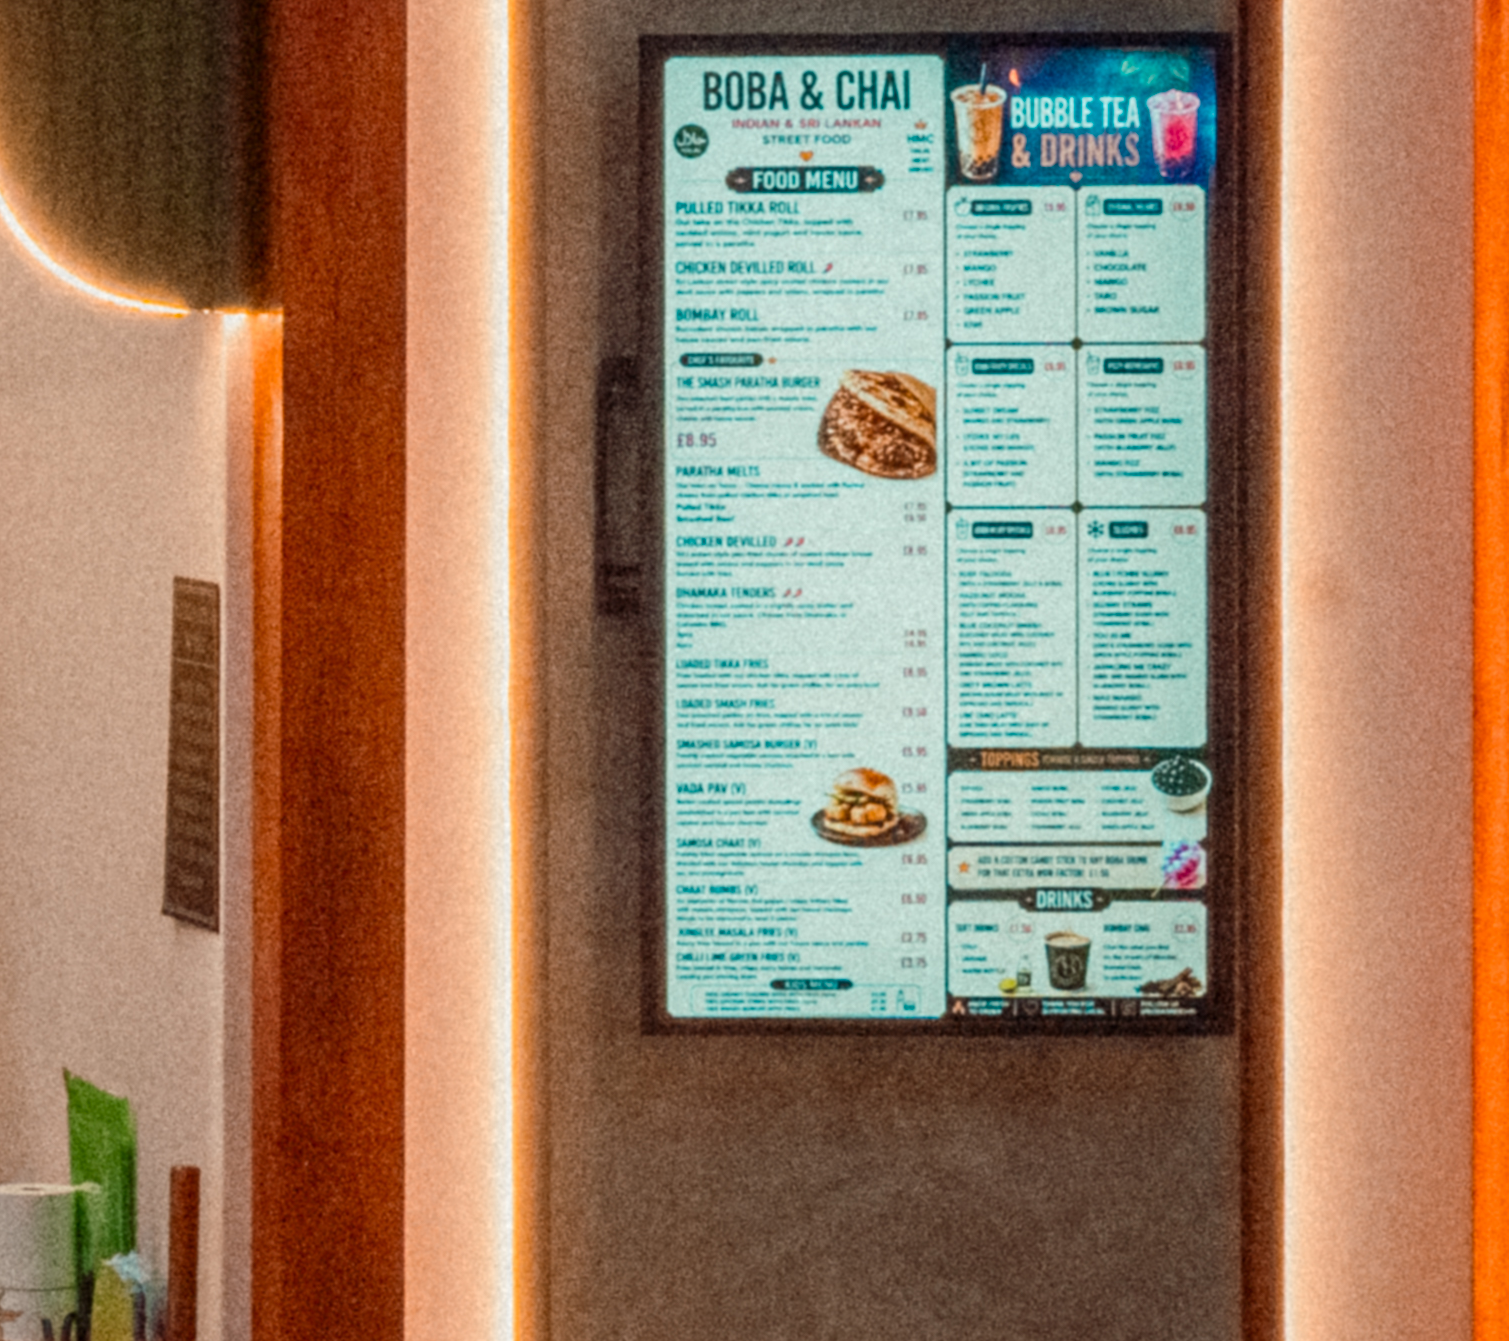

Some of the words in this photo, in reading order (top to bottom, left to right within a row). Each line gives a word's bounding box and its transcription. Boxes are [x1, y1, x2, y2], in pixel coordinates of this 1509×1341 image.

[703, 70, 789, 111] BOBA
[800, 70, 823, 111] &
[836, 70, 910, 111] CHAI
[1011, 97, 1094, 128] BUBBLE
[1099, 97, 1140, 128] TEA
[732, 119, 779, 128] INDIAN
[785, 119, 793, 128] &
[800, 119, 820, 128] SRI
[825, 119, 882, 128] LANKAN
[762, 135, 810, 145] STREET
[815, 135, 851, 145] FOOD
[1011, 133, 1031, 168] &
[1040, 133, 1140, 168] DRINKS
[752, 171, 800, 189] FOOD
[805, 171, 859, 189] MENU
[675, 201, 723, 214] PULLED
[728, 201, 765, 214] TIKKA
[769, 201, 800, 214] ROLL
[675, 260, 727, 274] CHICKEN
[730, 260, 784, 274] DEVILLED
[788, 260, 815, 274] ROLL
[675, 308, 726, 321] BOMBAY
[730, 308, 759, 321] ROLL
[677, 377, 693, 388] THE
[698, 377, 731, 388] SMASH
[735, 377, 778, 388] PARATHA
[782, 377, 820, 388] BURGER
[677, 433, 717, 448] £8.95
[676, 466, 723, 477] PARATHA
[727, 466, 761, 477] MELTS
[676, 536, 723, 547] CHICKEN
[727, 536, 777, 547] DEVILLED
[676, 587, 727, 598] DHAMAKA
[731, 587, 776, 598] TENDERS
[676, 659, 712, 669] LOADED
[715, 659, 740, 669] TIKKA
[744, 659, 769, 669] FRIES
[676, 699, 712, 709] LOADED
[715, 699, 747, 709] SMASH
[750, 699, 775, 709] FRIES
[677, 739, 720, 750] SMASHED
[724, 739, 761, 750] SAMOSA
[765, 739, 801, 750] BURGER
[981, 752, 1040, 767] TOPPINGS
[677, 783, 704, 794] VADA
[708, 783, 727, 794] PAV
[731, 783, 747, 794] (V)
[676, 839, 713, 848] SAMOSA
[716, 839, 745, 848] CHAAT
[978, 856, 992, 865] ADD
[1030, 856, 1053, 865] CANDY
[1056, 856, 1075, 865] STICK
[1105, 856, 1123, 865] BOBA
[978, 869, 991, 877] FOR
[994, 869, 1010, 877] THAT
[676, 885, 706, 895] CHAAT
[1036, 891, 1093, 909] DRINKS
[718, 928, 754, 937] MASALA
[956, 924, 972, 933] SOFT
